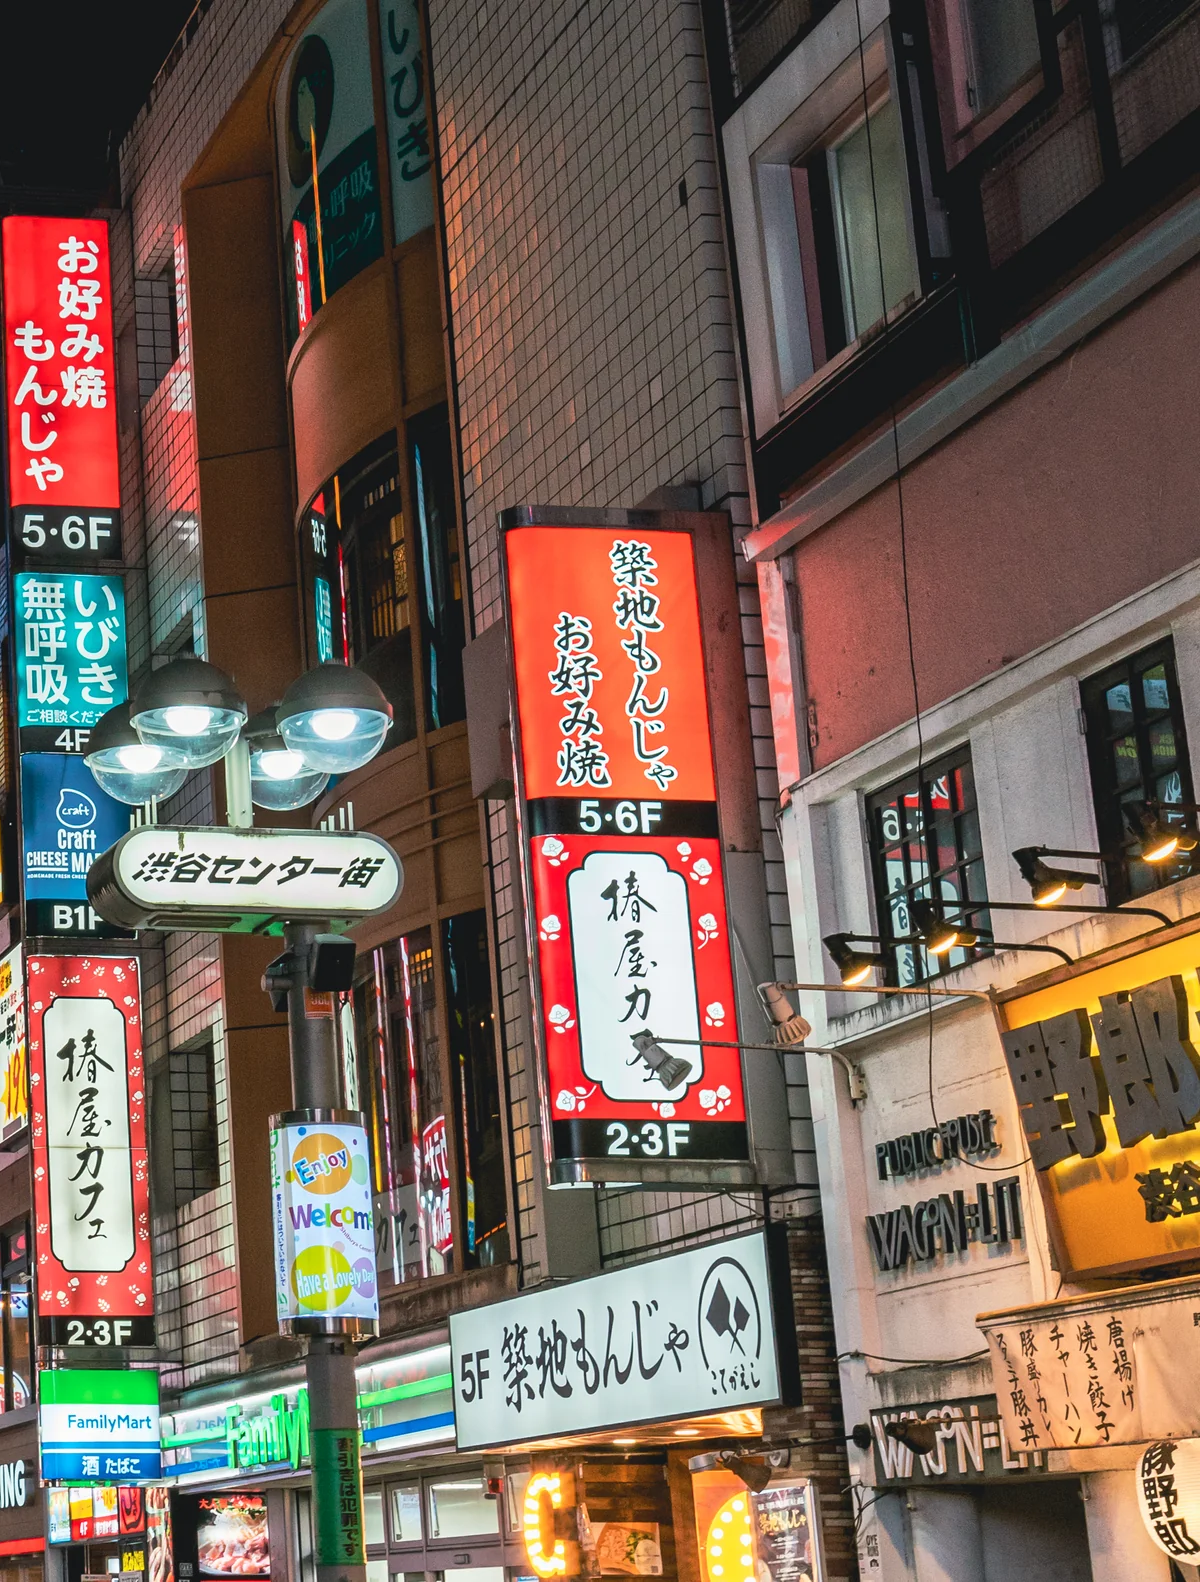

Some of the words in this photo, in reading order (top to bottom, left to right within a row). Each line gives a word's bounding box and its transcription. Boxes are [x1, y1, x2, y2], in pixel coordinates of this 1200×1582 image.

[57, 235, 107, 409] お好み焼
[14, 320, 65, 492] もんじゃ
[22, 578, 70, 705] 無呼吸
[74, 580, 120, 704] いびき
[610, 541, 676, 790] 築地もんじゃ
[55, 729, 91, 751] 4F
[551, 613, 609, 787] お好み焼
[26, 851, 69, 866] CHEESE
[57, 828, 97, 850] Craft
[62, 803, 91, 817] craft
[132, 852, 386, 889] 渋谷センター街
[56, 1028, 116, 1240] 椿屋カフェ
[293, 1147, 349, 1187] Enjoy
[295, 1269, 321, 1299] Have
[322, 1273, 329, 1290] a
[330, 1266, 362, 1290] Lovely
[361, 1268, 375, 1284] Day
[460, 1349, 490, 1403] 5F
[500, 1299, 690, 1413] 築地もんじゃ
[1049, 1324, 1083, 1445] チャーハン
[1077, 1320, 1116, 1443] 焼き餃子
[1106, 1315, 1135, 1412] 唐揚げ
[67, 1414, 152, 1433] FamilyMart
[81, 1455, 99, 1476] 酒
[105, 1457, 142, 1475] たばこ
[1140, 1441, 1200, 1556] 豚野郎
